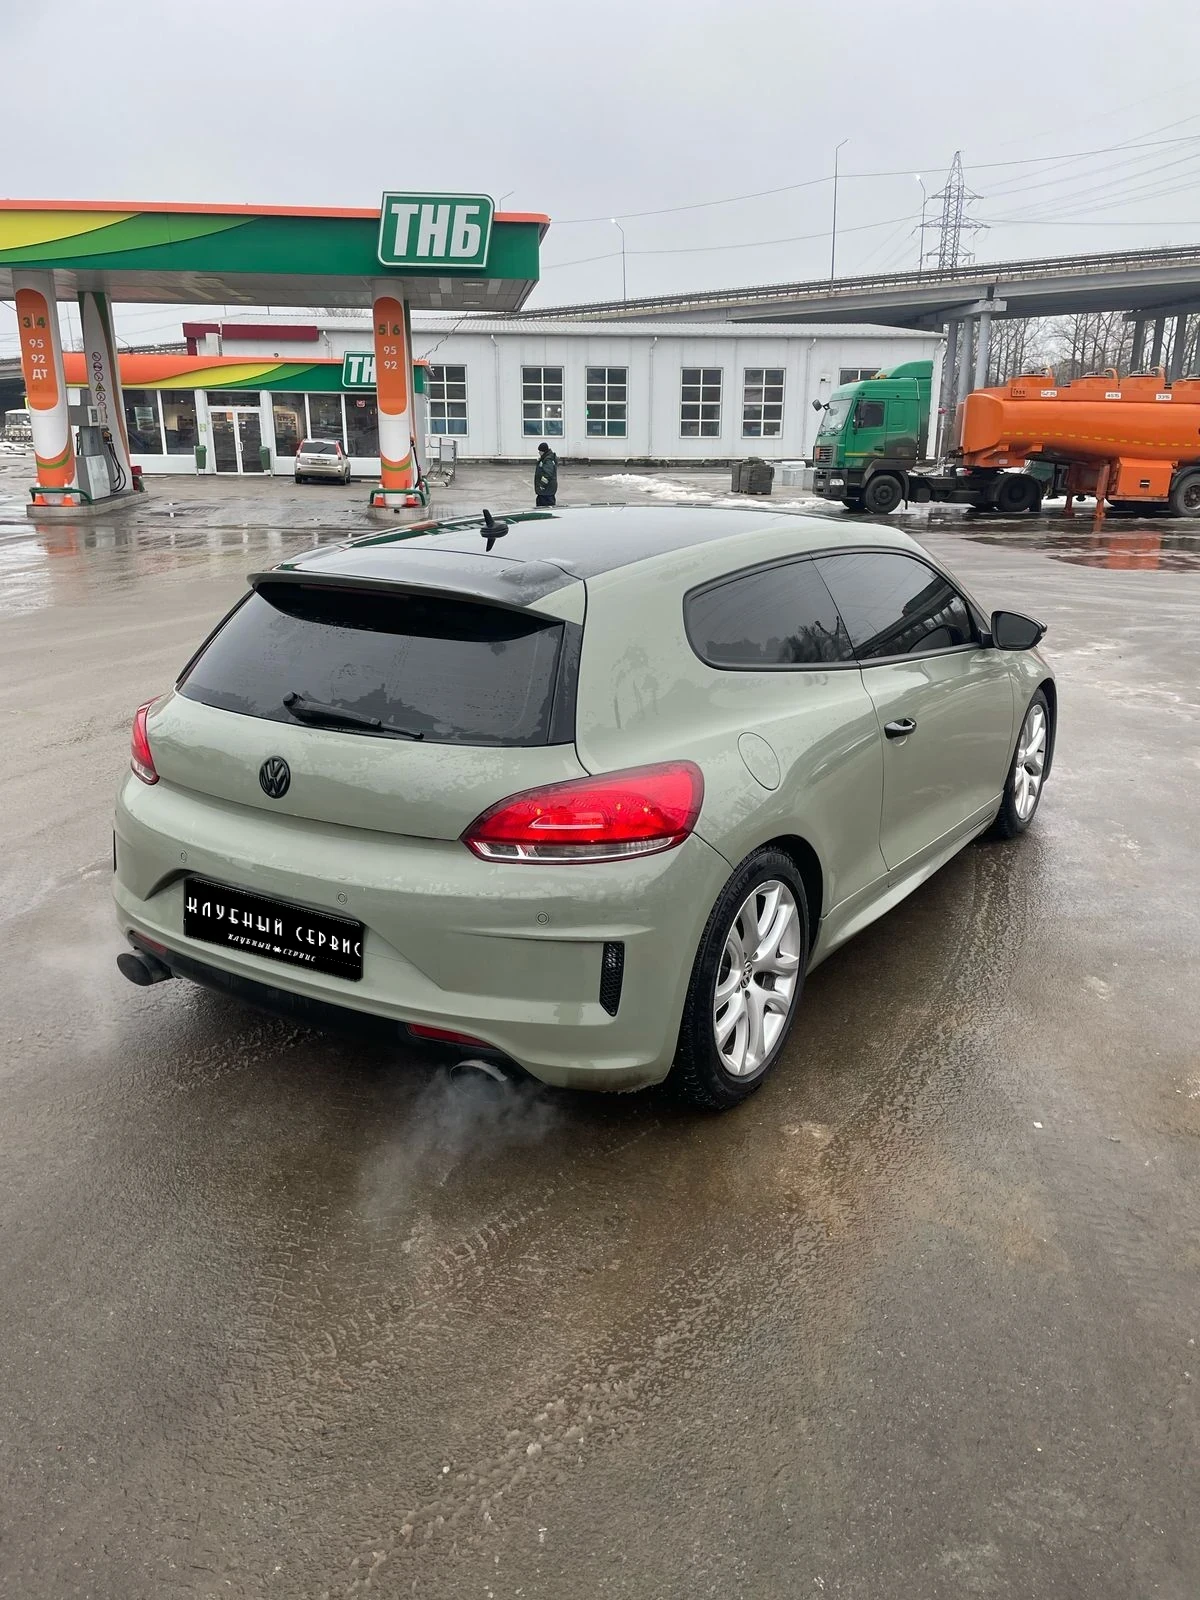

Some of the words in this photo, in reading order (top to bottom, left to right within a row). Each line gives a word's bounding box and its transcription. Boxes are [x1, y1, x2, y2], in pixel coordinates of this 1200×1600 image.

[391, 203, 481, 258] ТНБ
[29, 338, 44, 348] 95
[383, 346, 397, 355] 95
[31, 354, 46, 364] 92
[348, 356, 377, 383] ТН
[384, 361, 398, 370] 92
[32, 368, 48, 380] ДТ
